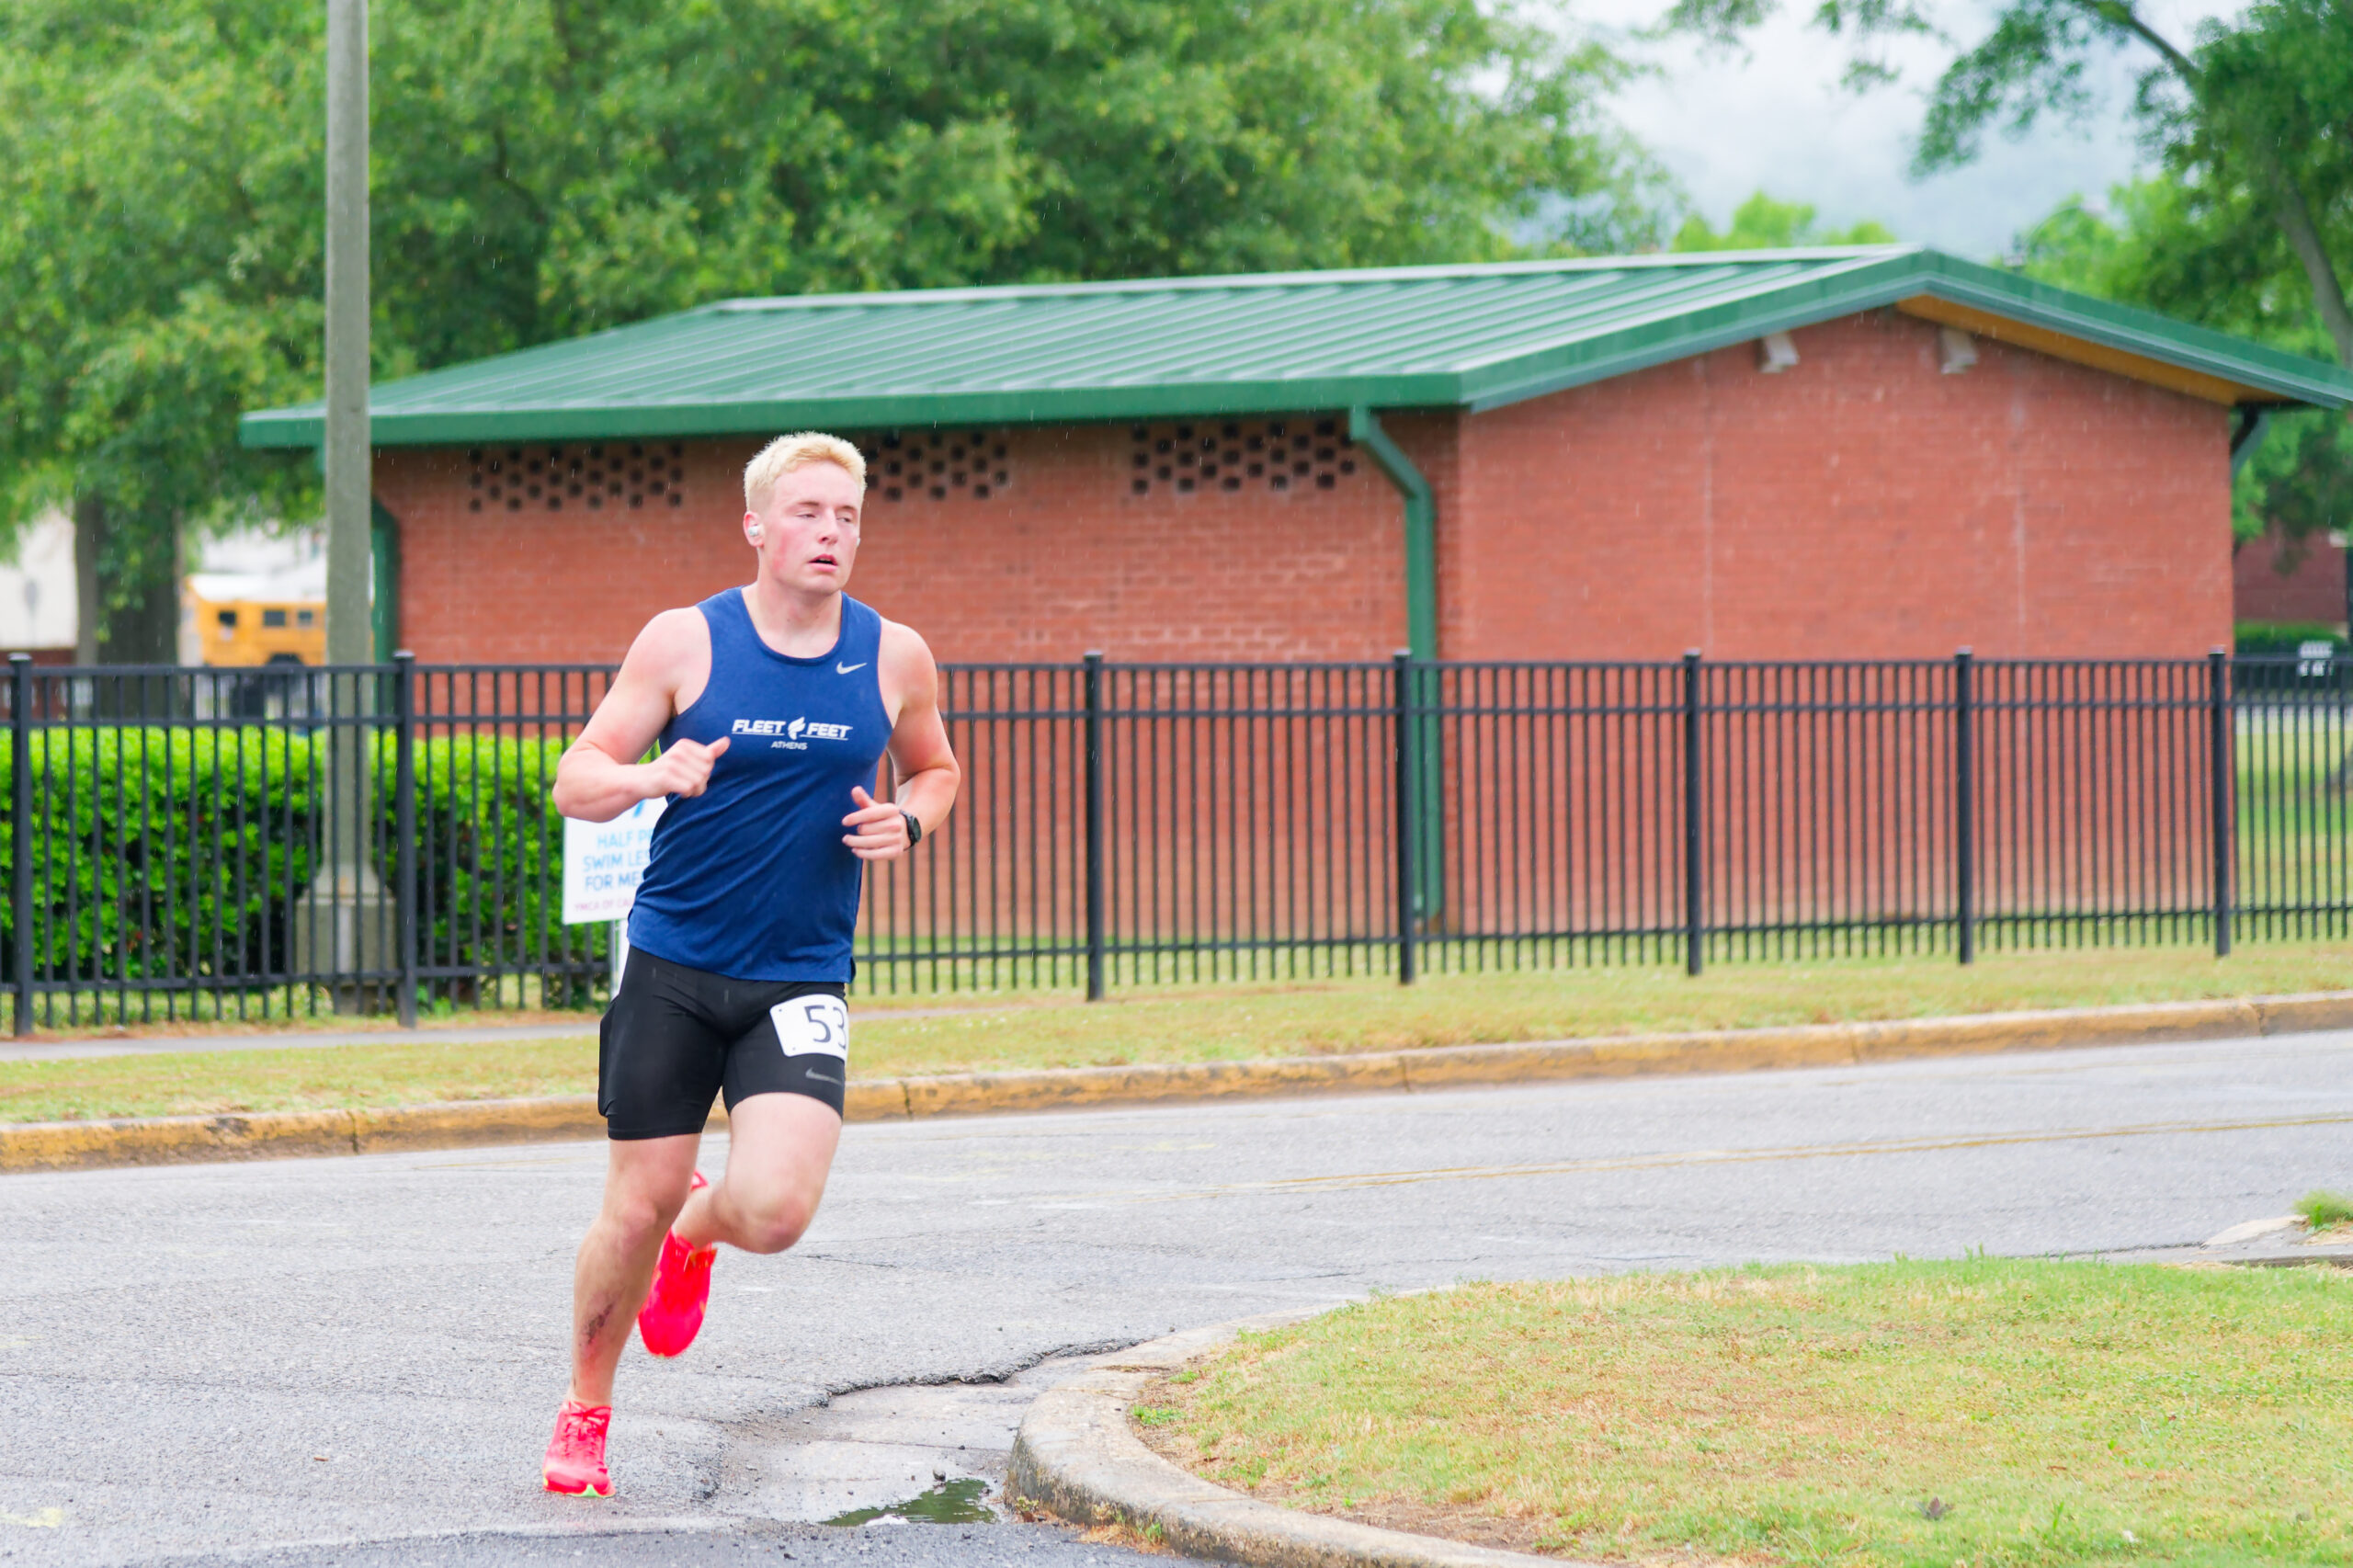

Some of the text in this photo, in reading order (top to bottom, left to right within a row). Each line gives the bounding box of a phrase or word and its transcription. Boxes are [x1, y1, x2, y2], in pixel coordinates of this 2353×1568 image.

[732, 719, 853, 738] FLEET FEET
[770, 741, 808, 750] ATHENS
[597, 830, 633, 849] HALF
[582, 853, 623, 872] SWIM
[585, 871, 644, 893] FOR ME
[803, 1004, 847, 1051] 53
